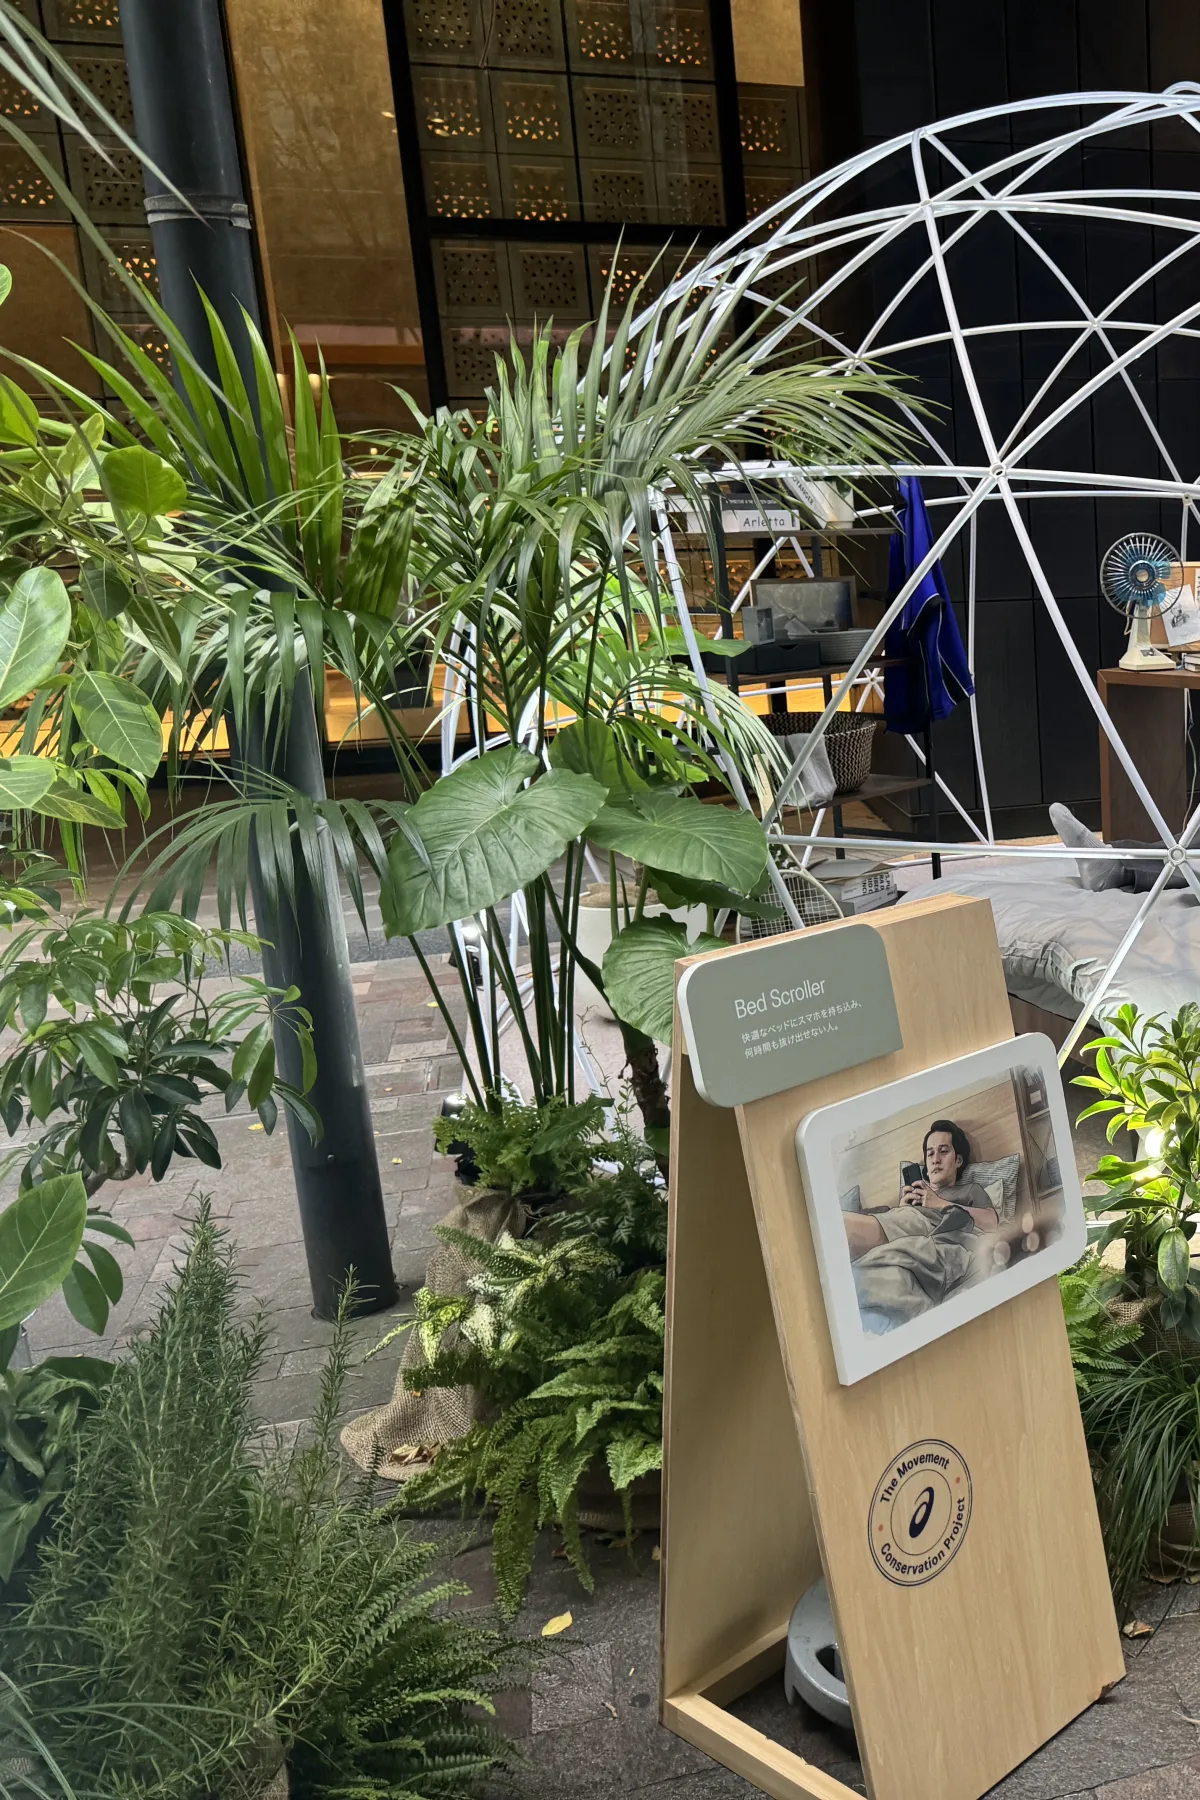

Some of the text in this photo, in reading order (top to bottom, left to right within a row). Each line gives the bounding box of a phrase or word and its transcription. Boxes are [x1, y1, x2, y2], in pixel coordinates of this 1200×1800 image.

[734, 979, 826, 1019] Bed Scroller
[741, 1000, 862, 1044] 快適なベッドにスマホを持ち込み、
[744, 1022, 839, 1059] 何時間も抜け出せない人。
[880, 1453, 950, 1503] The Movement
[881, 1497, 965, 1575] Conservation Project
